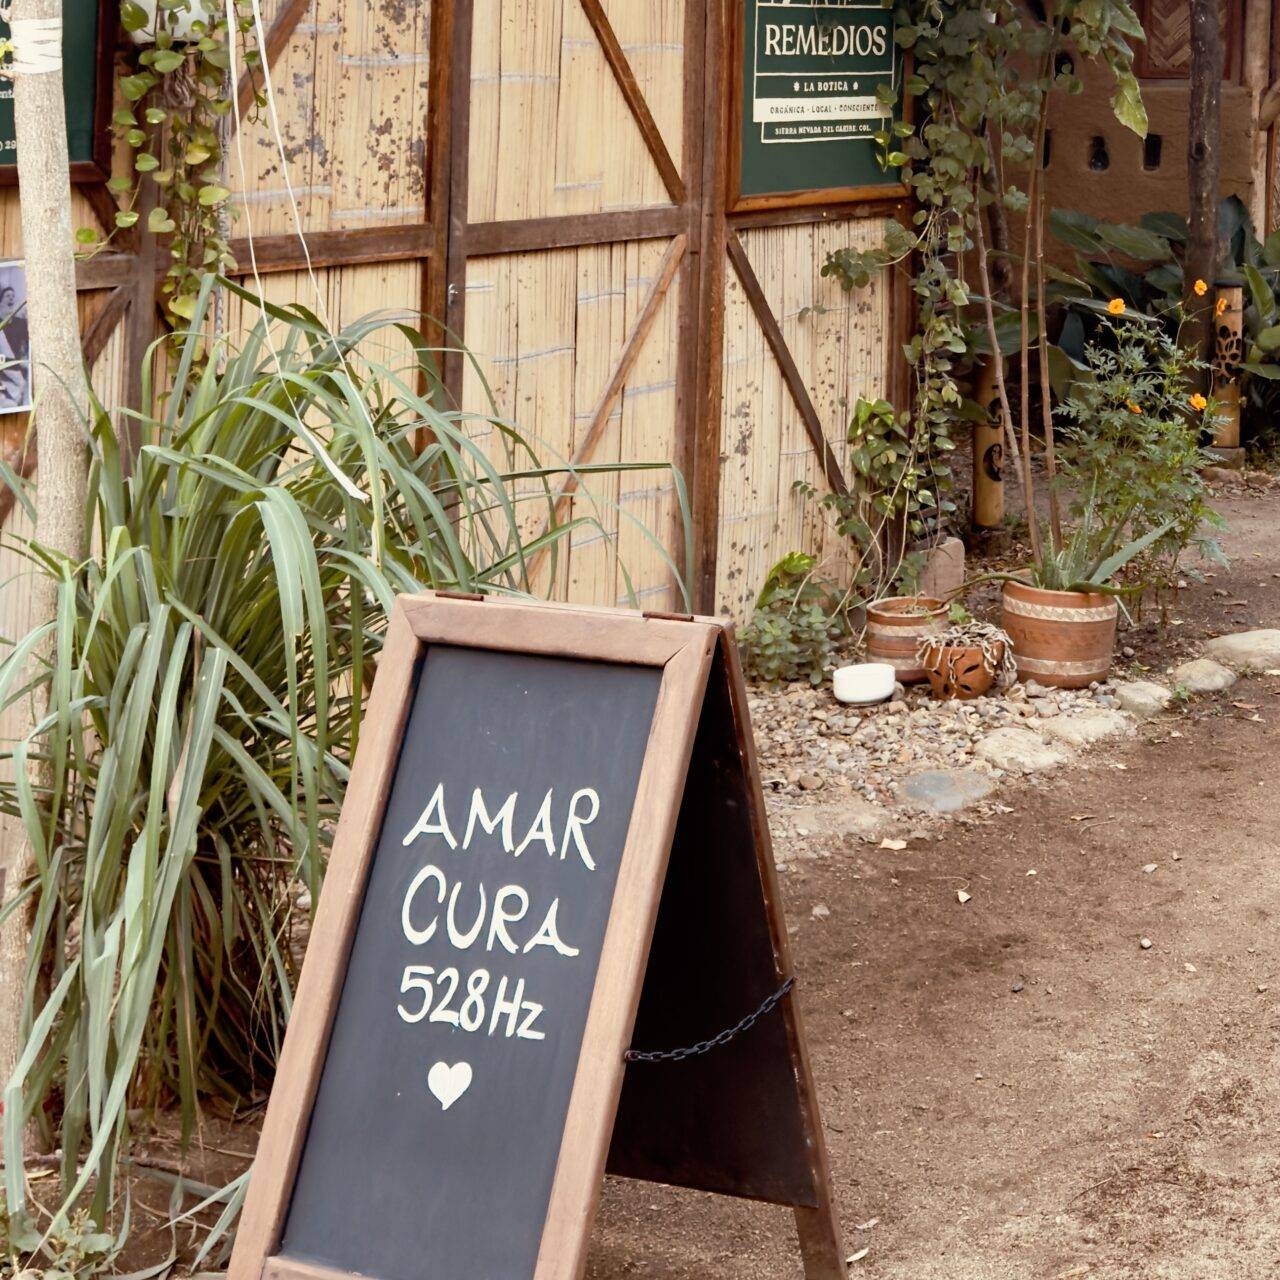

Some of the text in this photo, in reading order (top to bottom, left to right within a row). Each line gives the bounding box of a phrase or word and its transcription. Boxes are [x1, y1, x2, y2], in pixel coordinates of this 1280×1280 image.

[764, 24, 887, 56] REMEDIOS
[803, 81, 849, 92] LA BOTICA
[770, 104, 805, 114] ORGÁNICA
[811, 104, 832, 113] LOCAL
[775, 127, 797, 135] SIERRA
[798, 126, 822, 134] NEVADA
[822, 125, 835, 133] DEL
[402, 783, 600, 870] AMAR
[400, 864, 580, 957] CURA
[396, 964, 546, 1040] 528Hz
